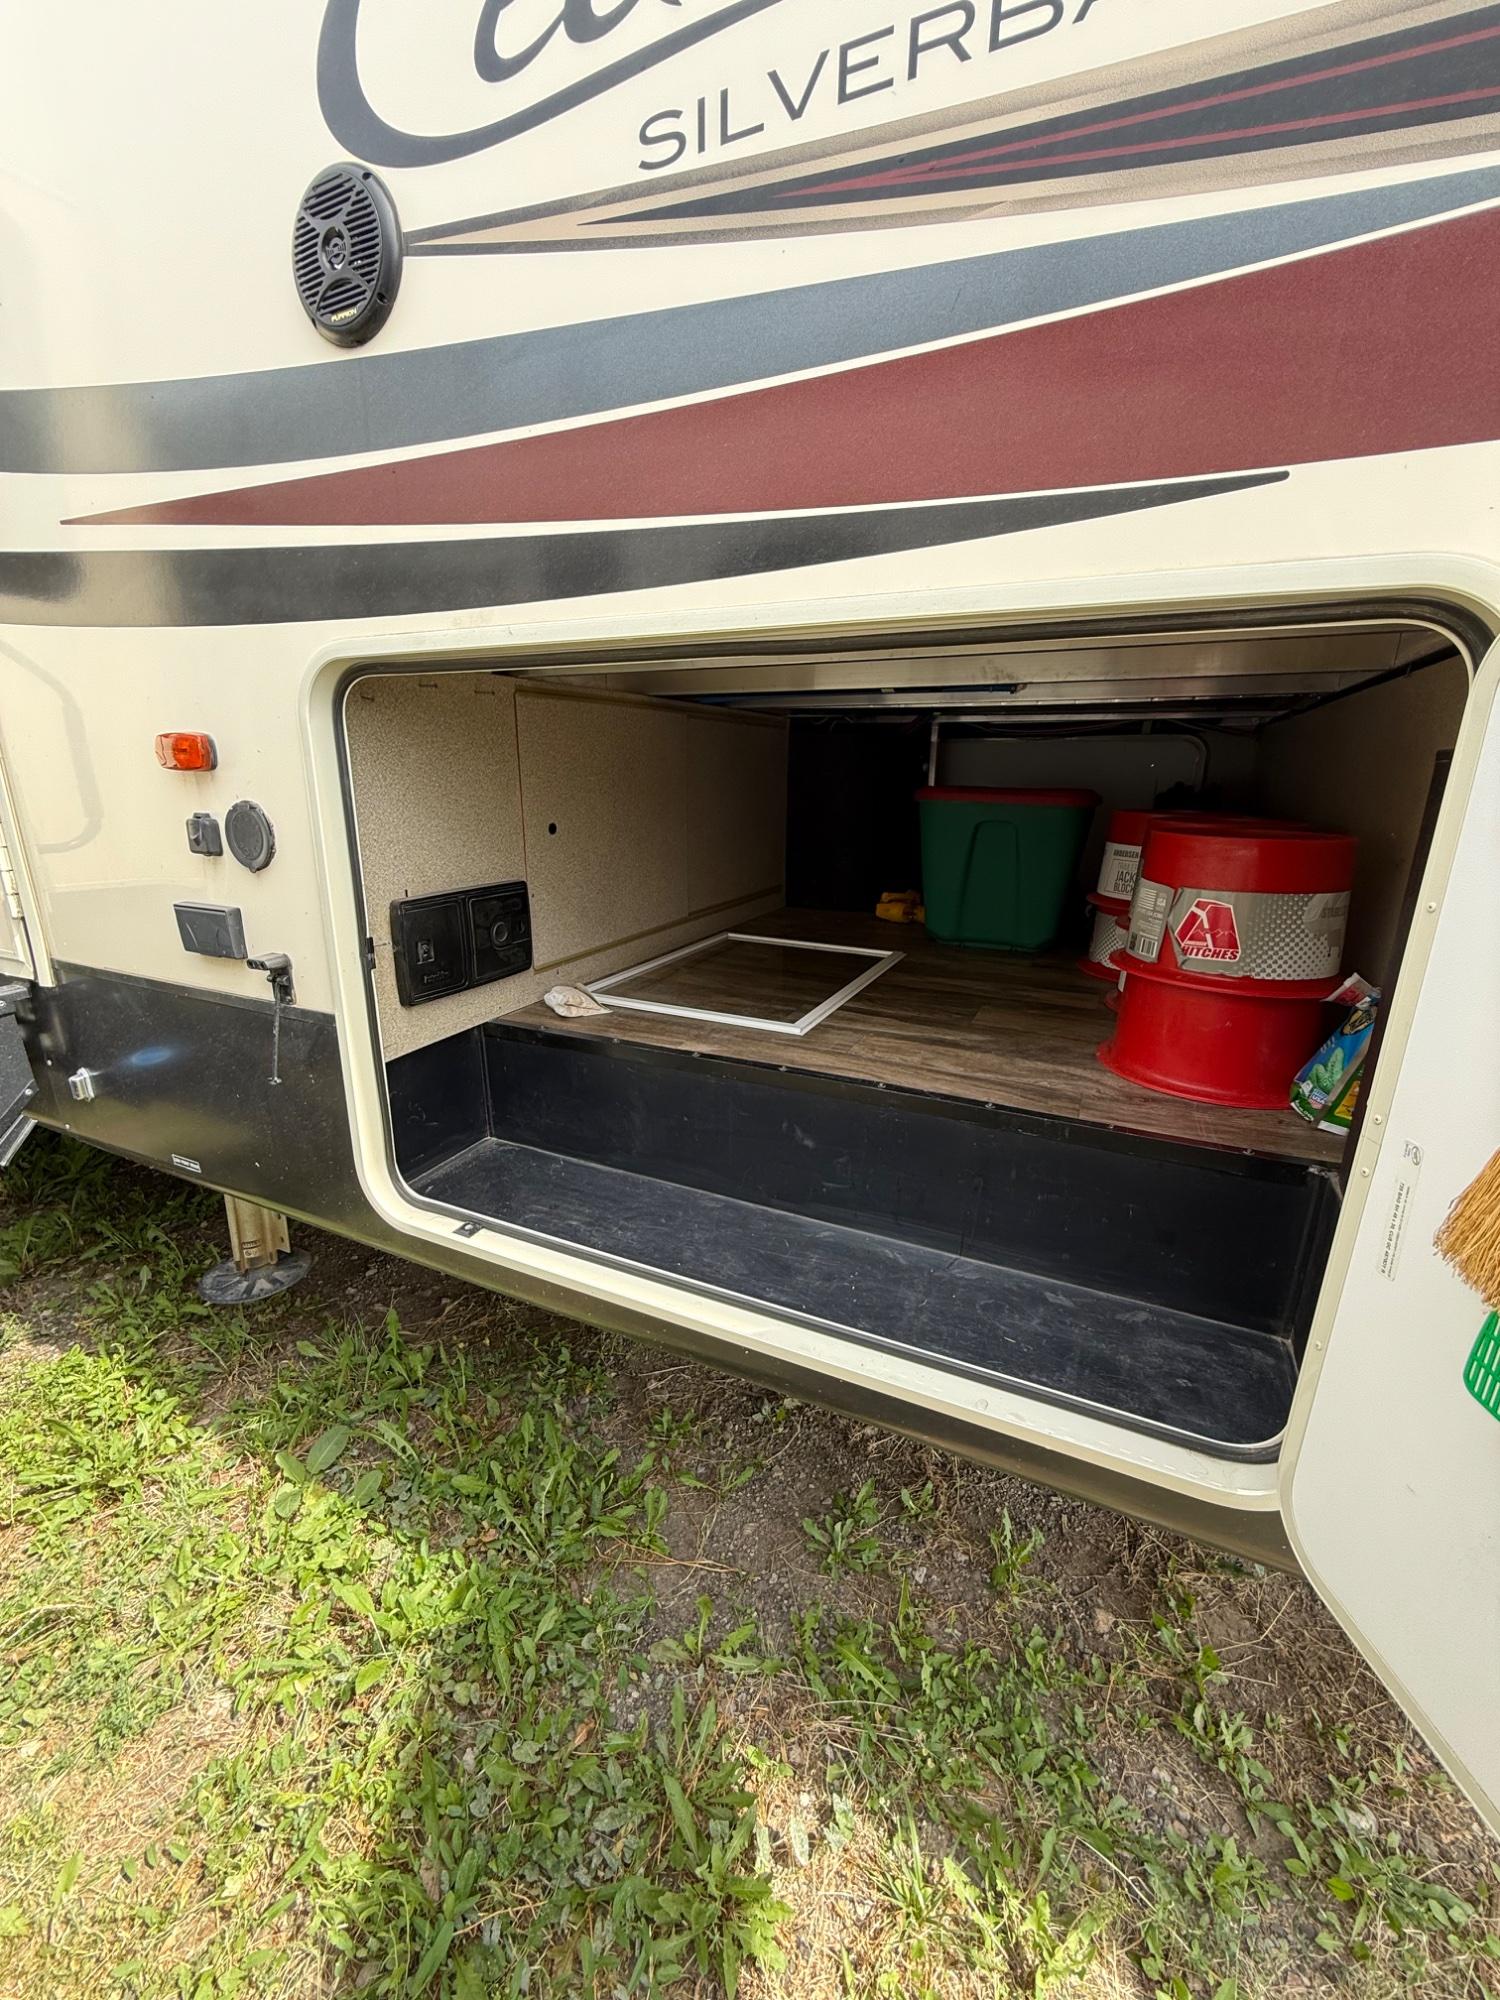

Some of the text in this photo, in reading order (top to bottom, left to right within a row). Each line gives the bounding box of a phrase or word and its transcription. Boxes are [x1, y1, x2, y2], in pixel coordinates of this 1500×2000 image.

[638, 0, 1098, 172] SILVERB
[1112, 848, 1139, 859] ANDERSEN
[1182, 945, 1240, 961] HITCHES
